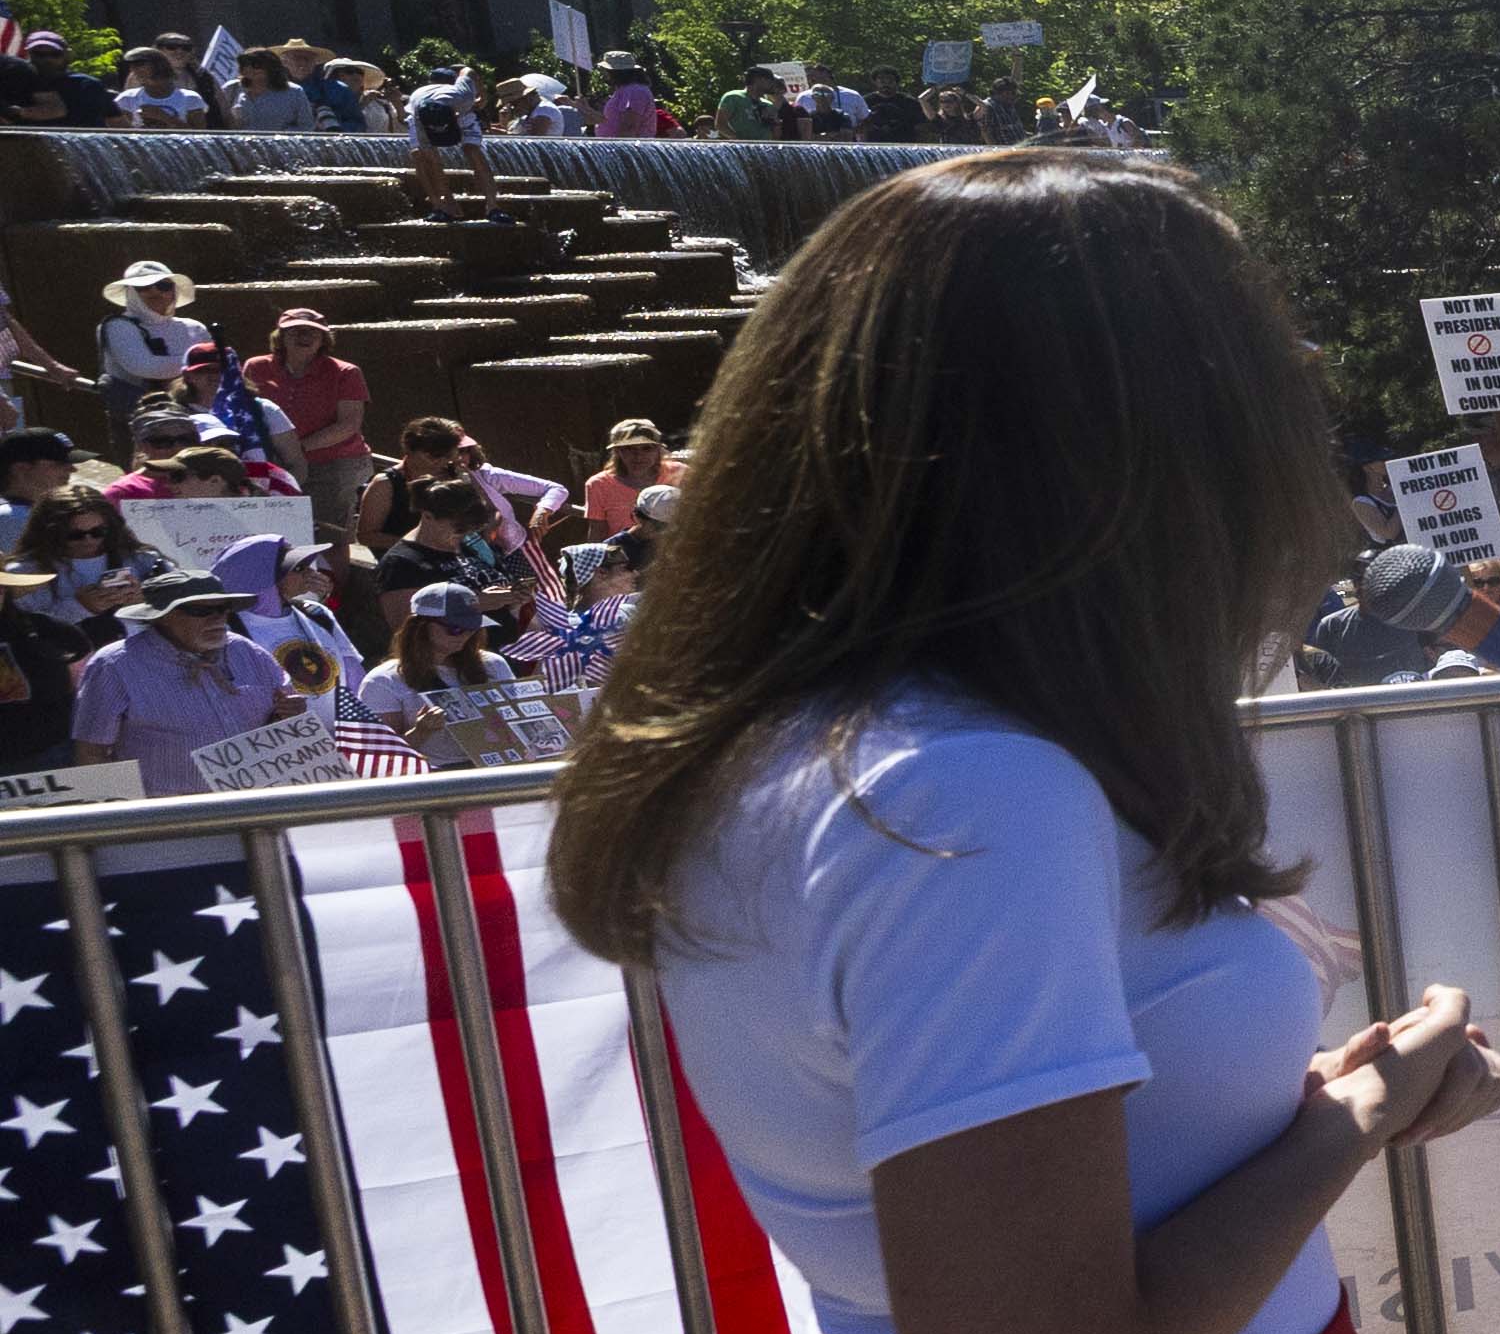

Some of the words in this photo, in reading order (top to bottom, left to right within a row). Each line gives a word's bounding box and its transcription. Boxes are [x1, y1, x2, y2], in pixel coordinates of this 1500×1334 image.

[1442, 299, 1472, 315] NOT
[1473, 297, 1495, 313] MY
[1450, 358, 1472, 374] NO
[1465, 377, 1482, 392] IN
[1407, 455, 1438, 474] NOT
[1438, 450, 1460, 467] MY
[1399, 465, 1480, 496] PRESIDENT!
[1417, 515, 1439, 532] NO
[1440, 506, 1484, 527] KINGS
[1431, 533, 1448, 550] IN
[1449, 527, 1480, 545] OUR
[199, 746, 243, 773] NO
[248, 716, 322, 757] KINGS
[213, 765, 256, 792] NO
[254, 736, 337, 776] TYRANTS
